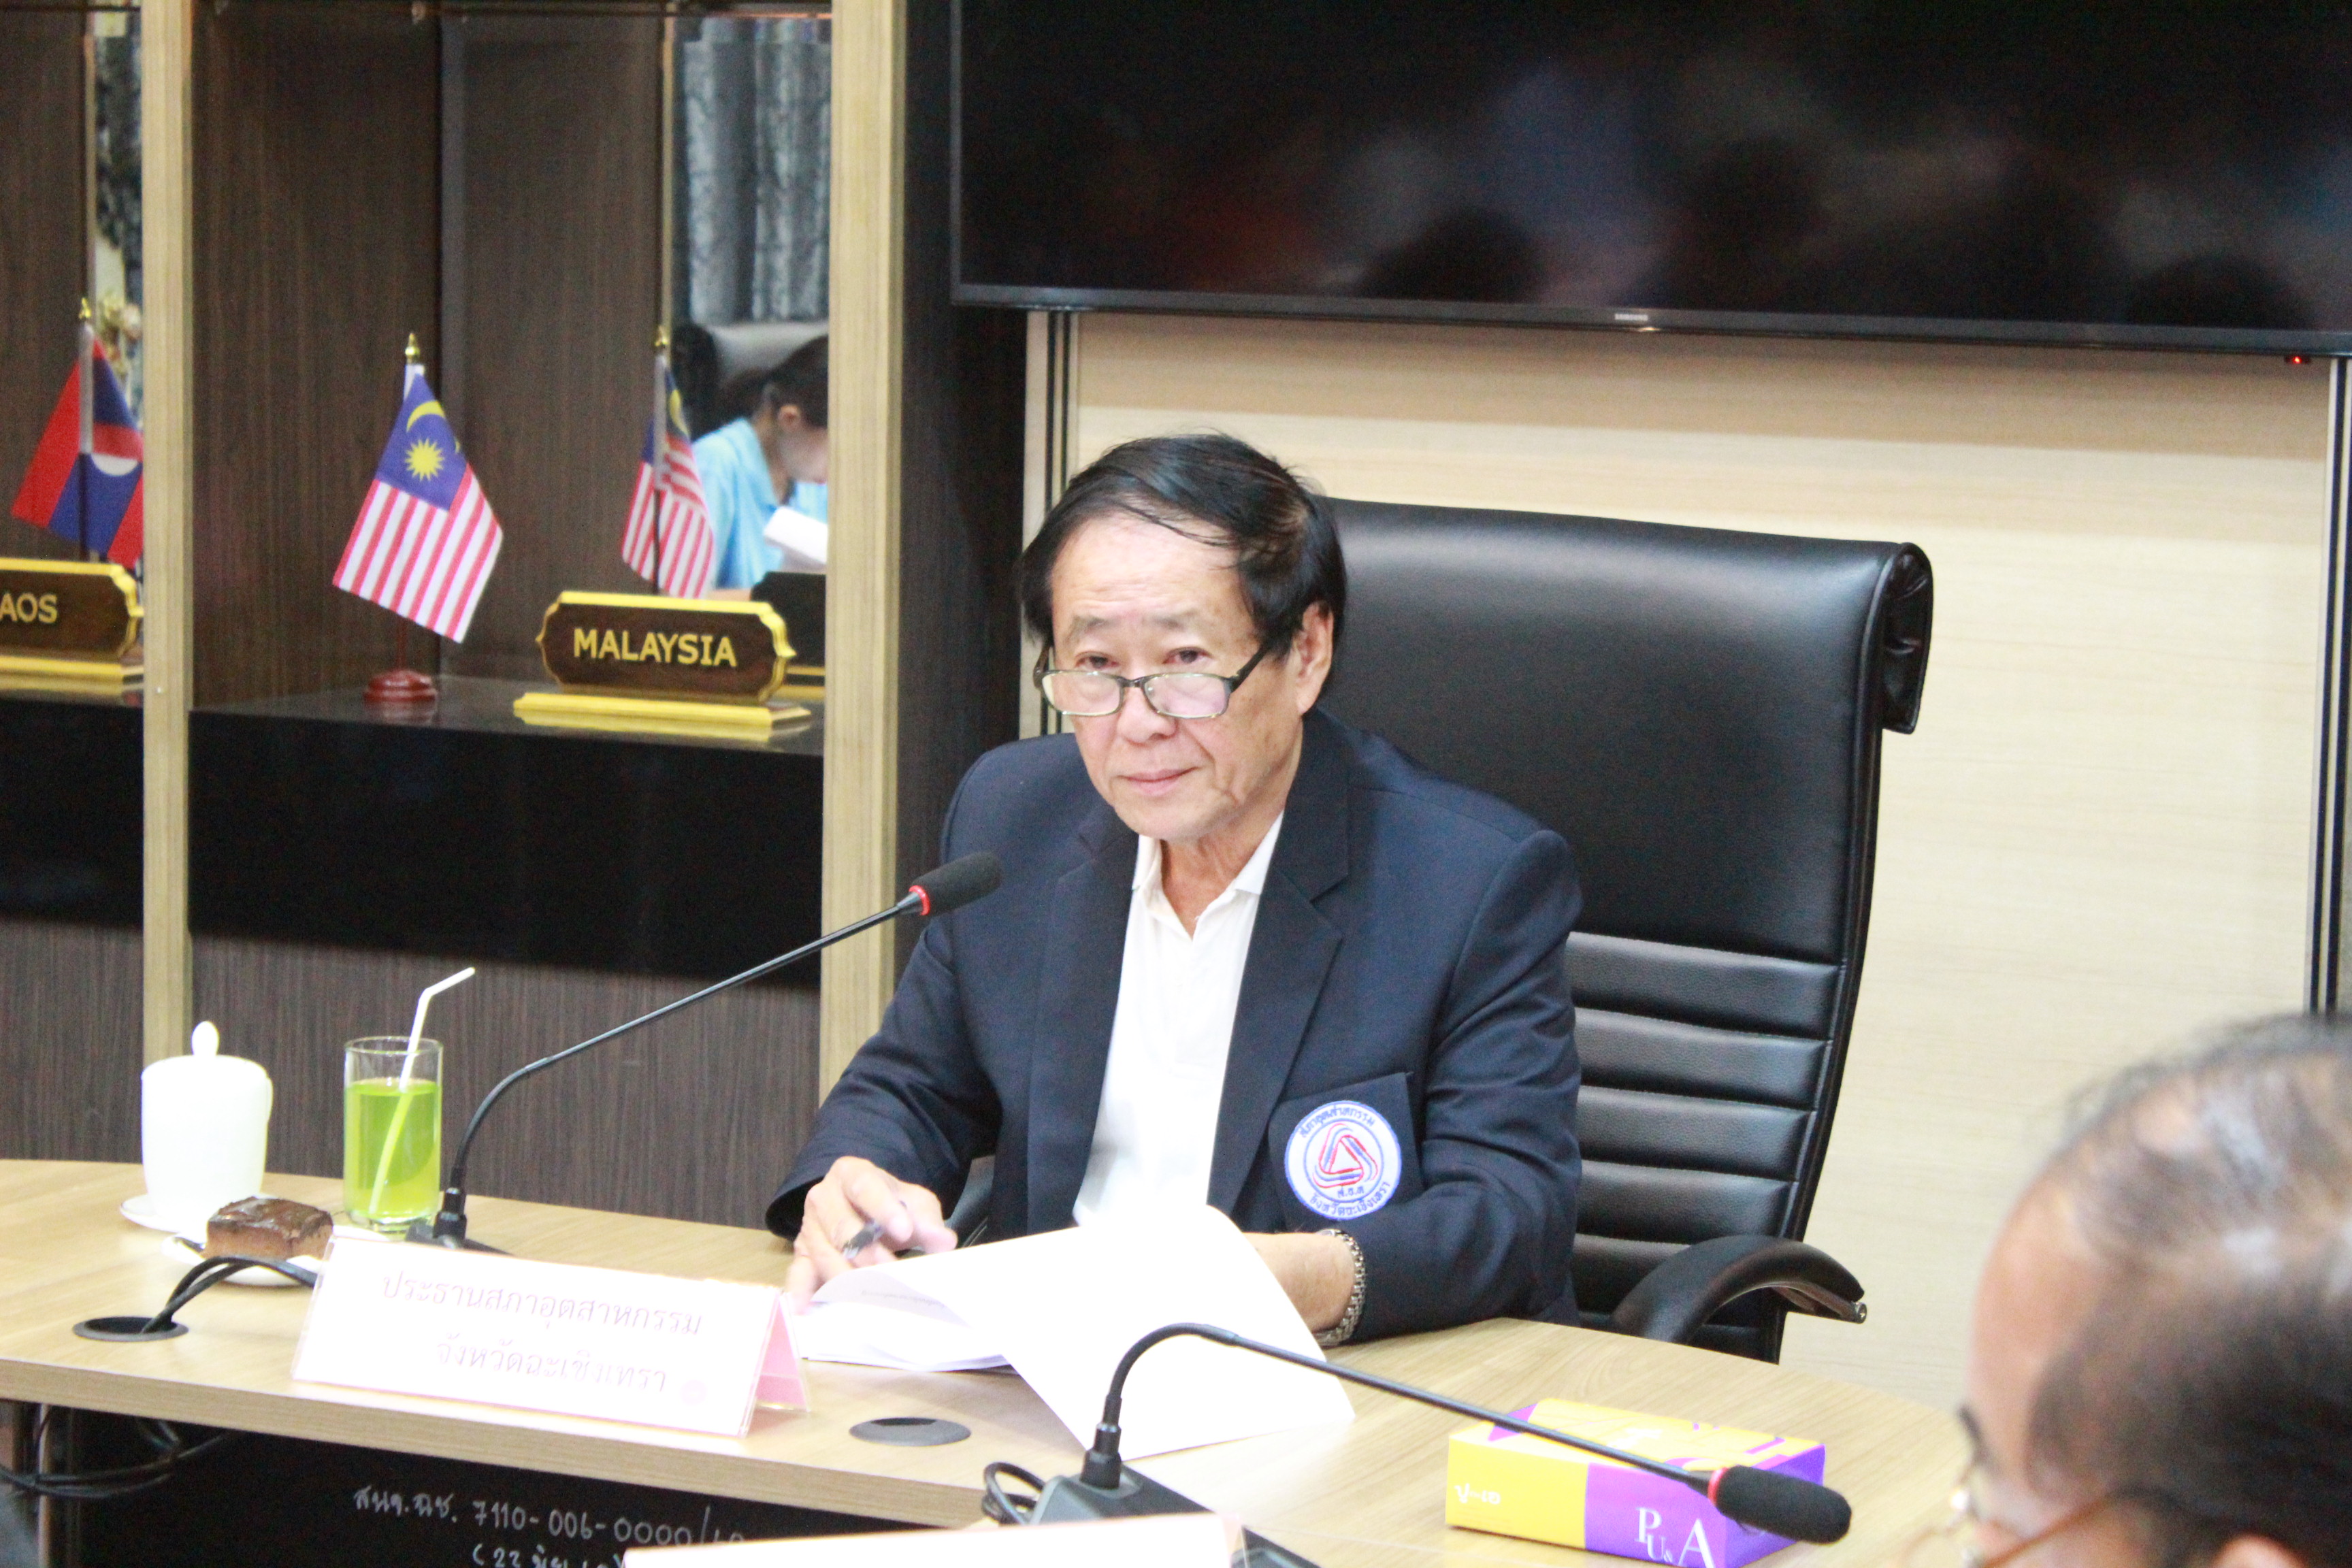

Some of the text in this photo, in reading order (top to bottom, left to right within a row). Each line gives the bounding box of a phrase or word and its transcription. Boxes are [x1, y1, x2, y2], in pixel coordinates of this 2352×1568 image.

[574, 627, 737, 667] MALAYSIA
[383, 1271, 702, 1335] ประธานสภาอุตสาหกรรม
[437, 1332, 667, 1392] จังหวัดฉะเชิงเทรา
